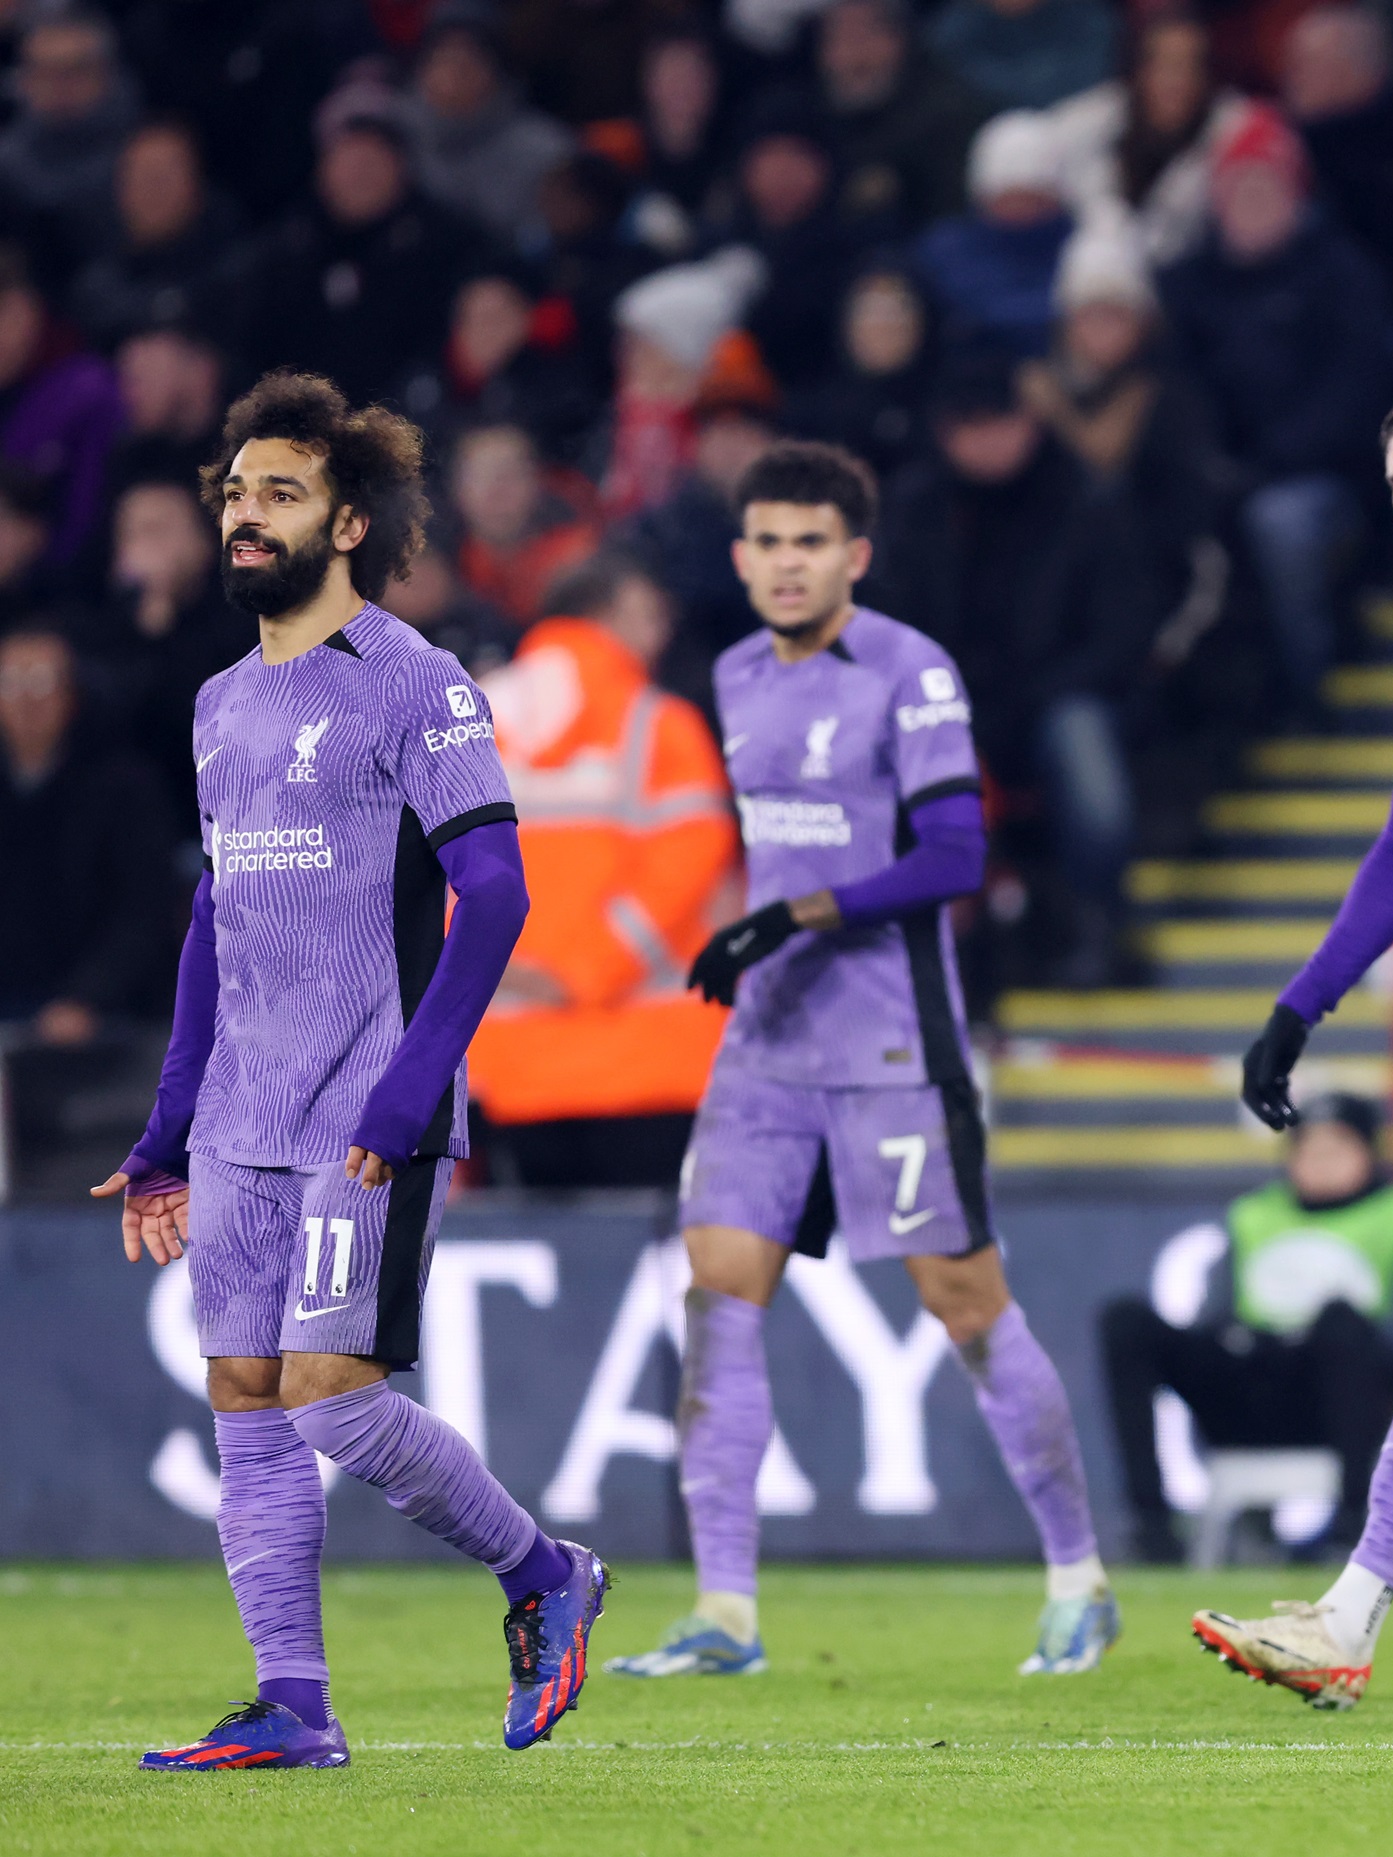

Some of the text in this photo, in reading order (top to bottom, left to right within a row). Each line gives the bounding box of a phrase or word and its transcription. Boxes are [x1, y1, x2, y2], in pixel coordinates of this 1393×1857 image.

[224, 824, 323, 850] standard
[226, 846, 332, 873] chartered
[879, 1133, 926, 1212] 7
[304, 1217, 354, 1297] 11
